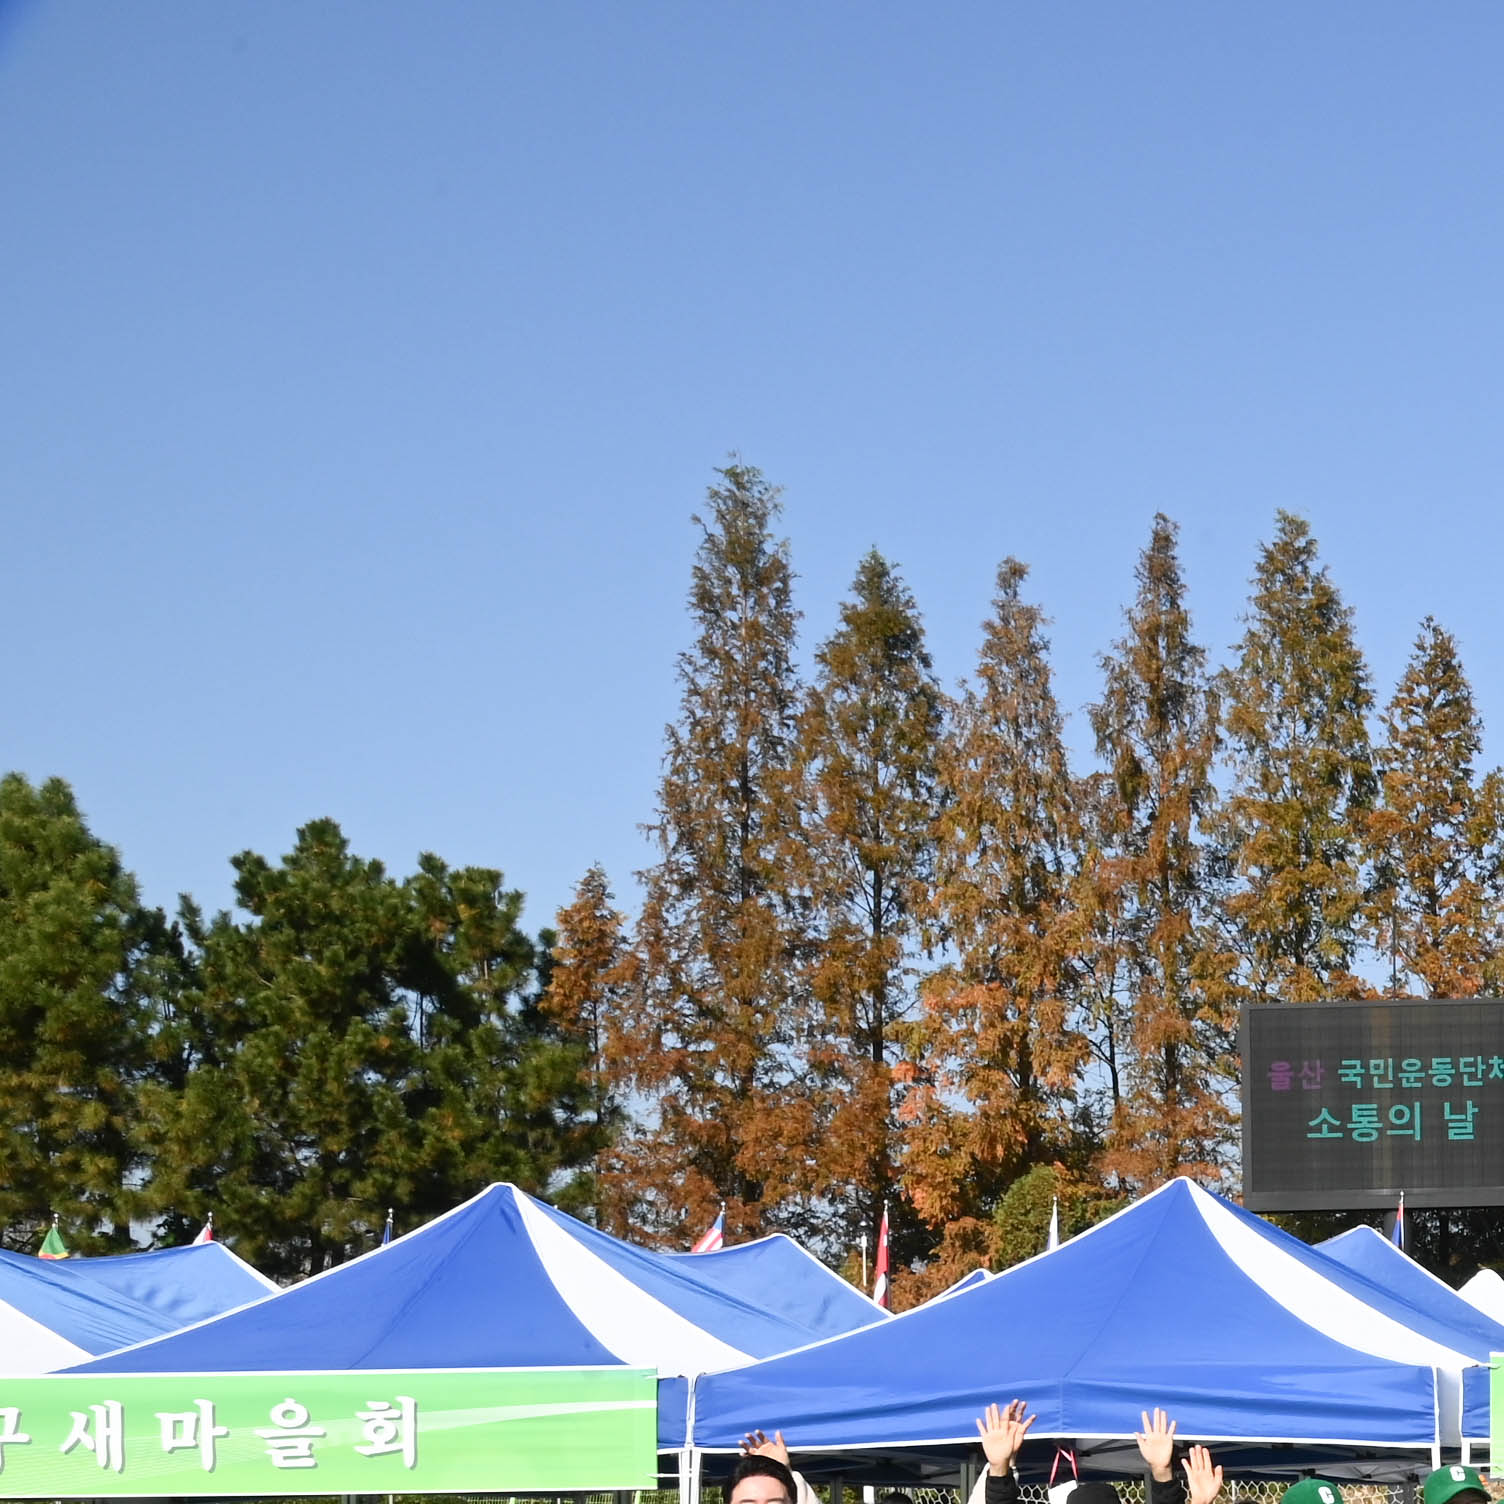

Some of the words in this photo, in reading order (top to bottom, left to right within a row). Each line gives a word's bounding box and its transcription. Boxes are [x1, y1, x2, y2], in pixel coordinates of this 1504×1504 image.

[1267, 1059, 1325, 1091] 울산
[1306, 1102, 1422, 1142] 소통의
[1443, 1100, 1479, 1141] 날
[1318, 1486, 1335, 1504] C
